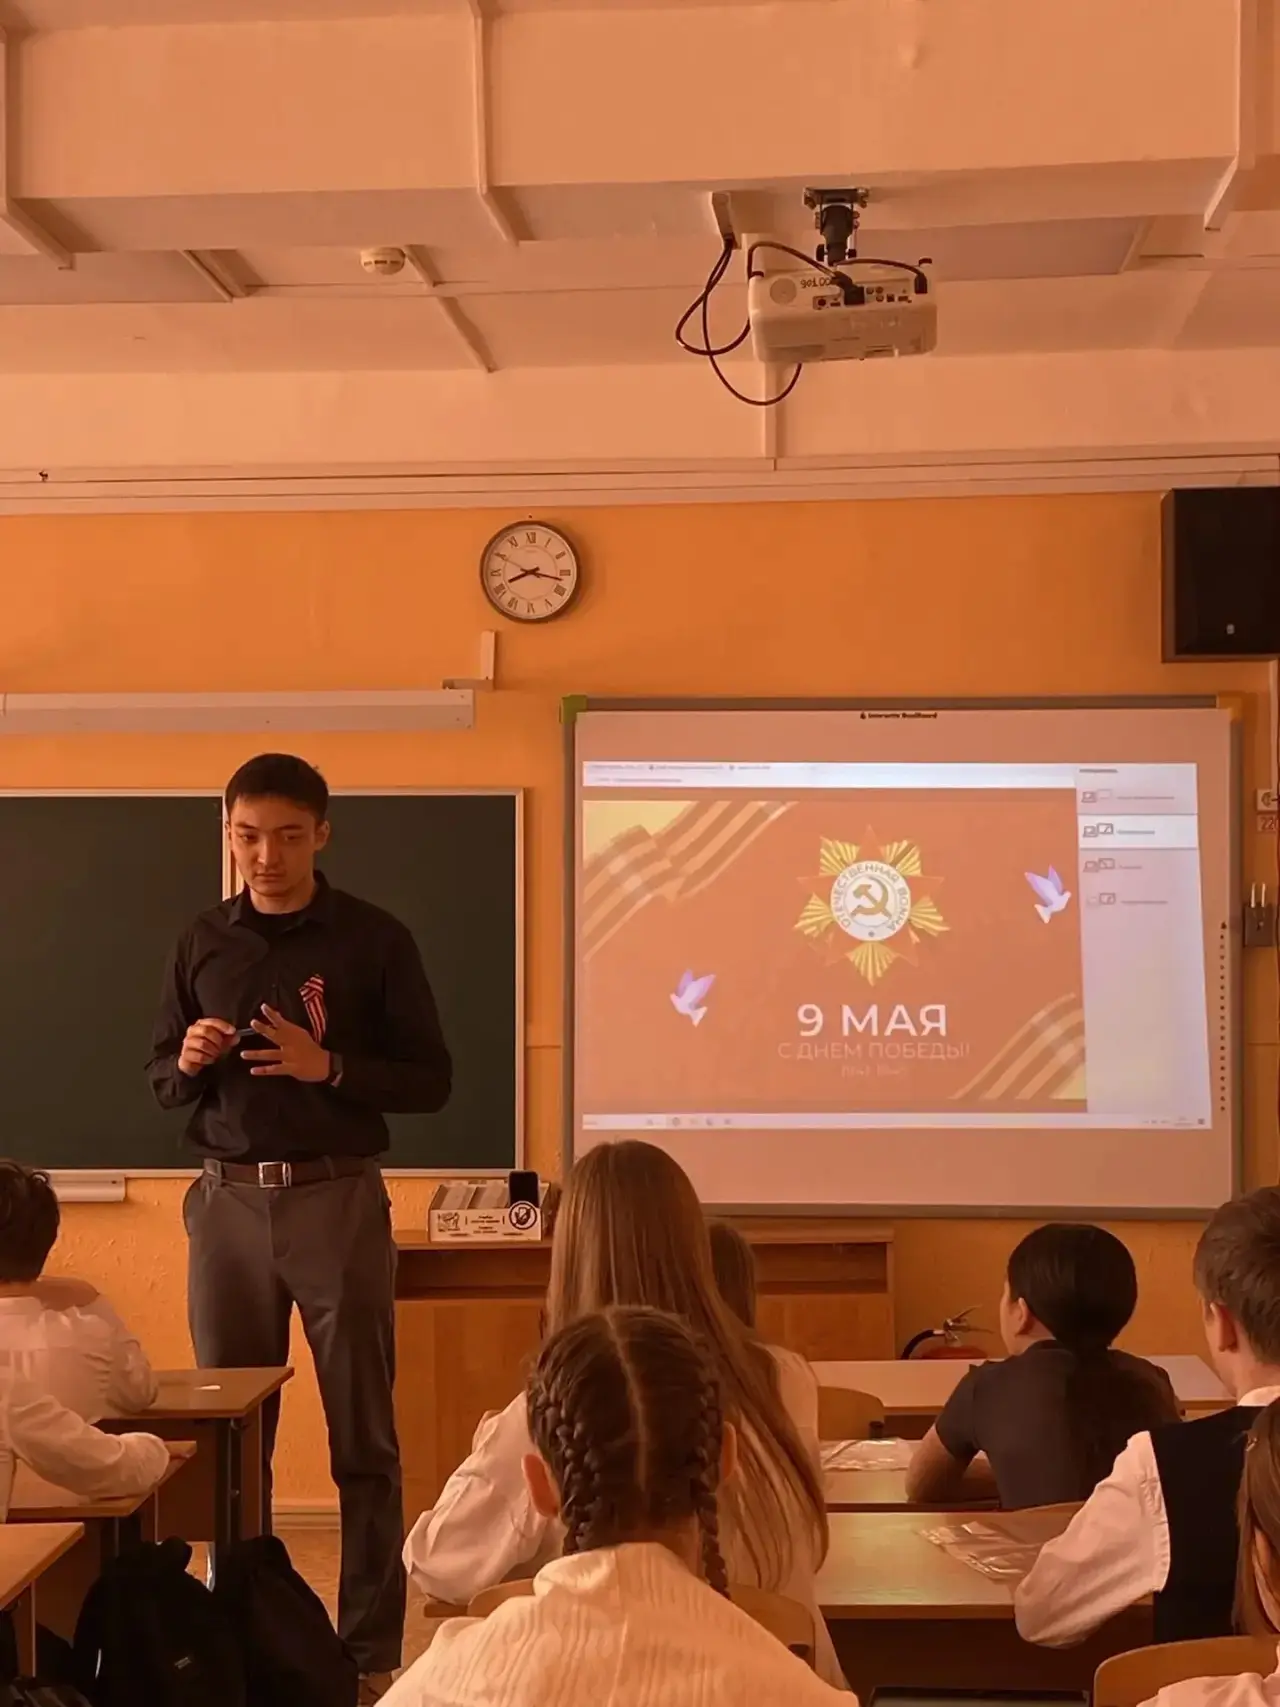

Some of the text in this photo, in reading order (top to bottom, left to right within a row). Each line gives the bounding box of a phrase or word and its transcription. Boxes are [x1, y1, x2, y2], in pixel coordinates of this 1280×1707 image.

[797, 1003, 947, 1037] 9 МАЯ
[777, 1042, 970, 1061] С ДНЕМ ПОБЕДЫ!
